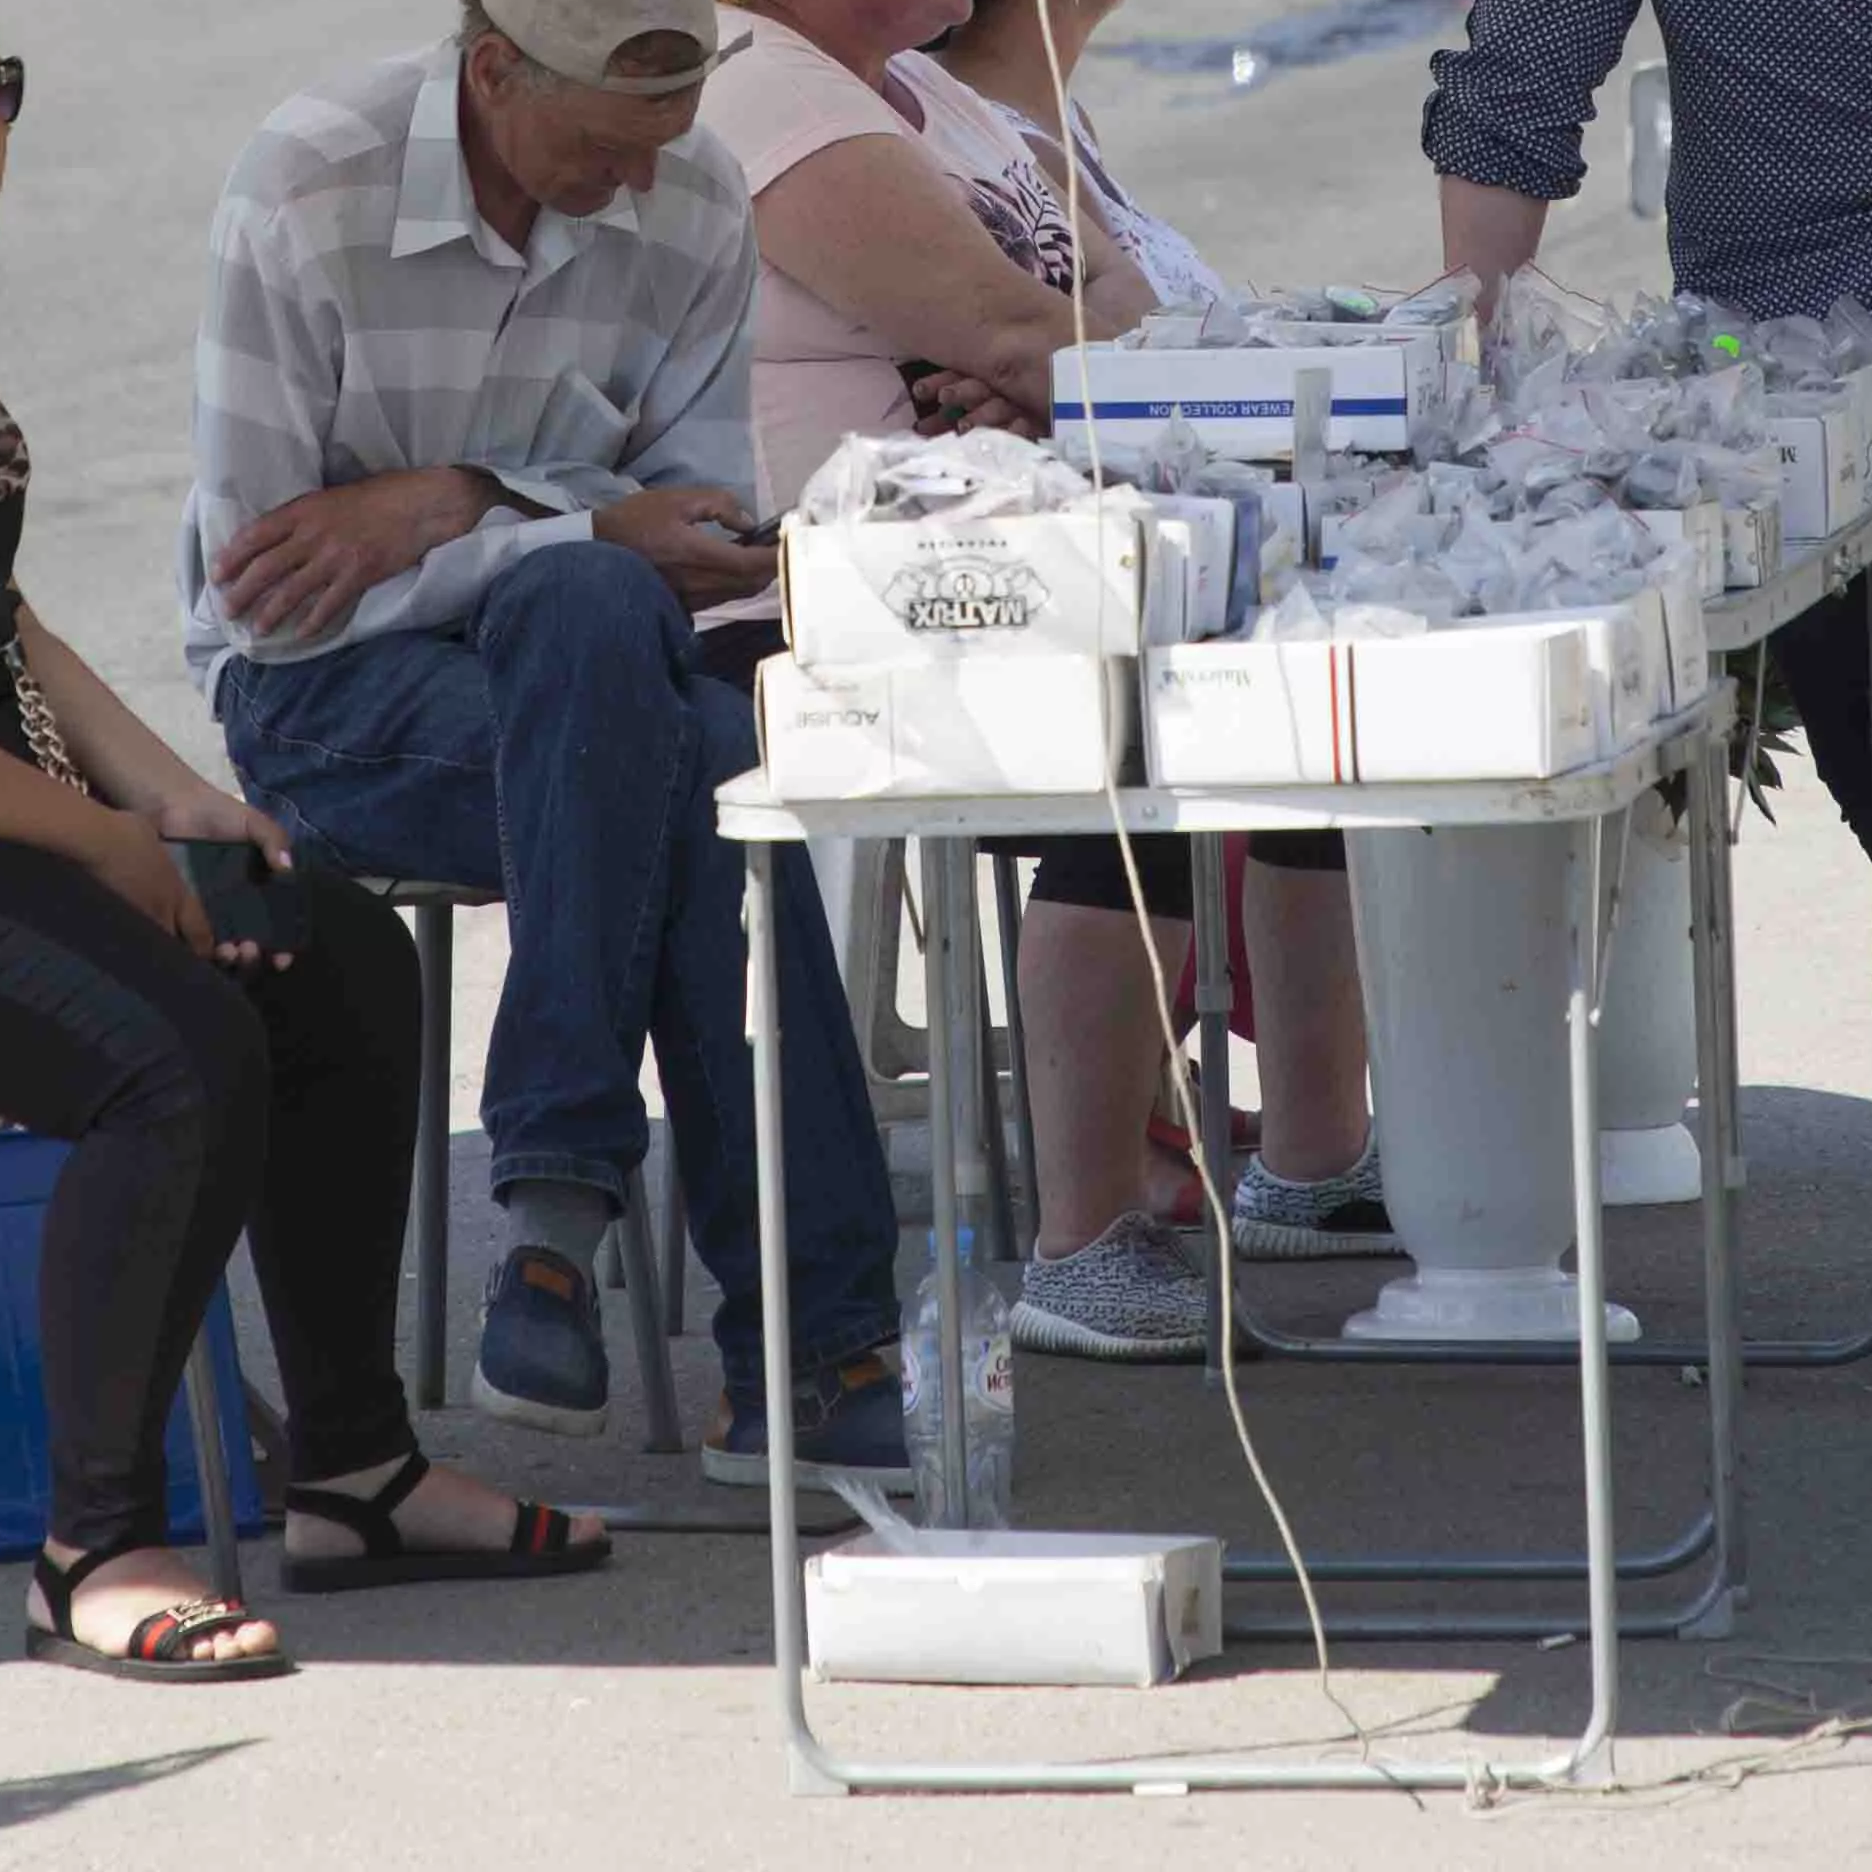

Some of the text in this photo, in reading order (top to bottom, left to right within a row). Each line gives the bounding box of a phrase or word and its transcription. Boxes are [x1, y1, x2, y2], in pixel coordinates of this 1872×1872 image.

[1148, 401, 1294, 418] EWEAR COLLECION
[911, 598, 1027, 629] MATRIX
